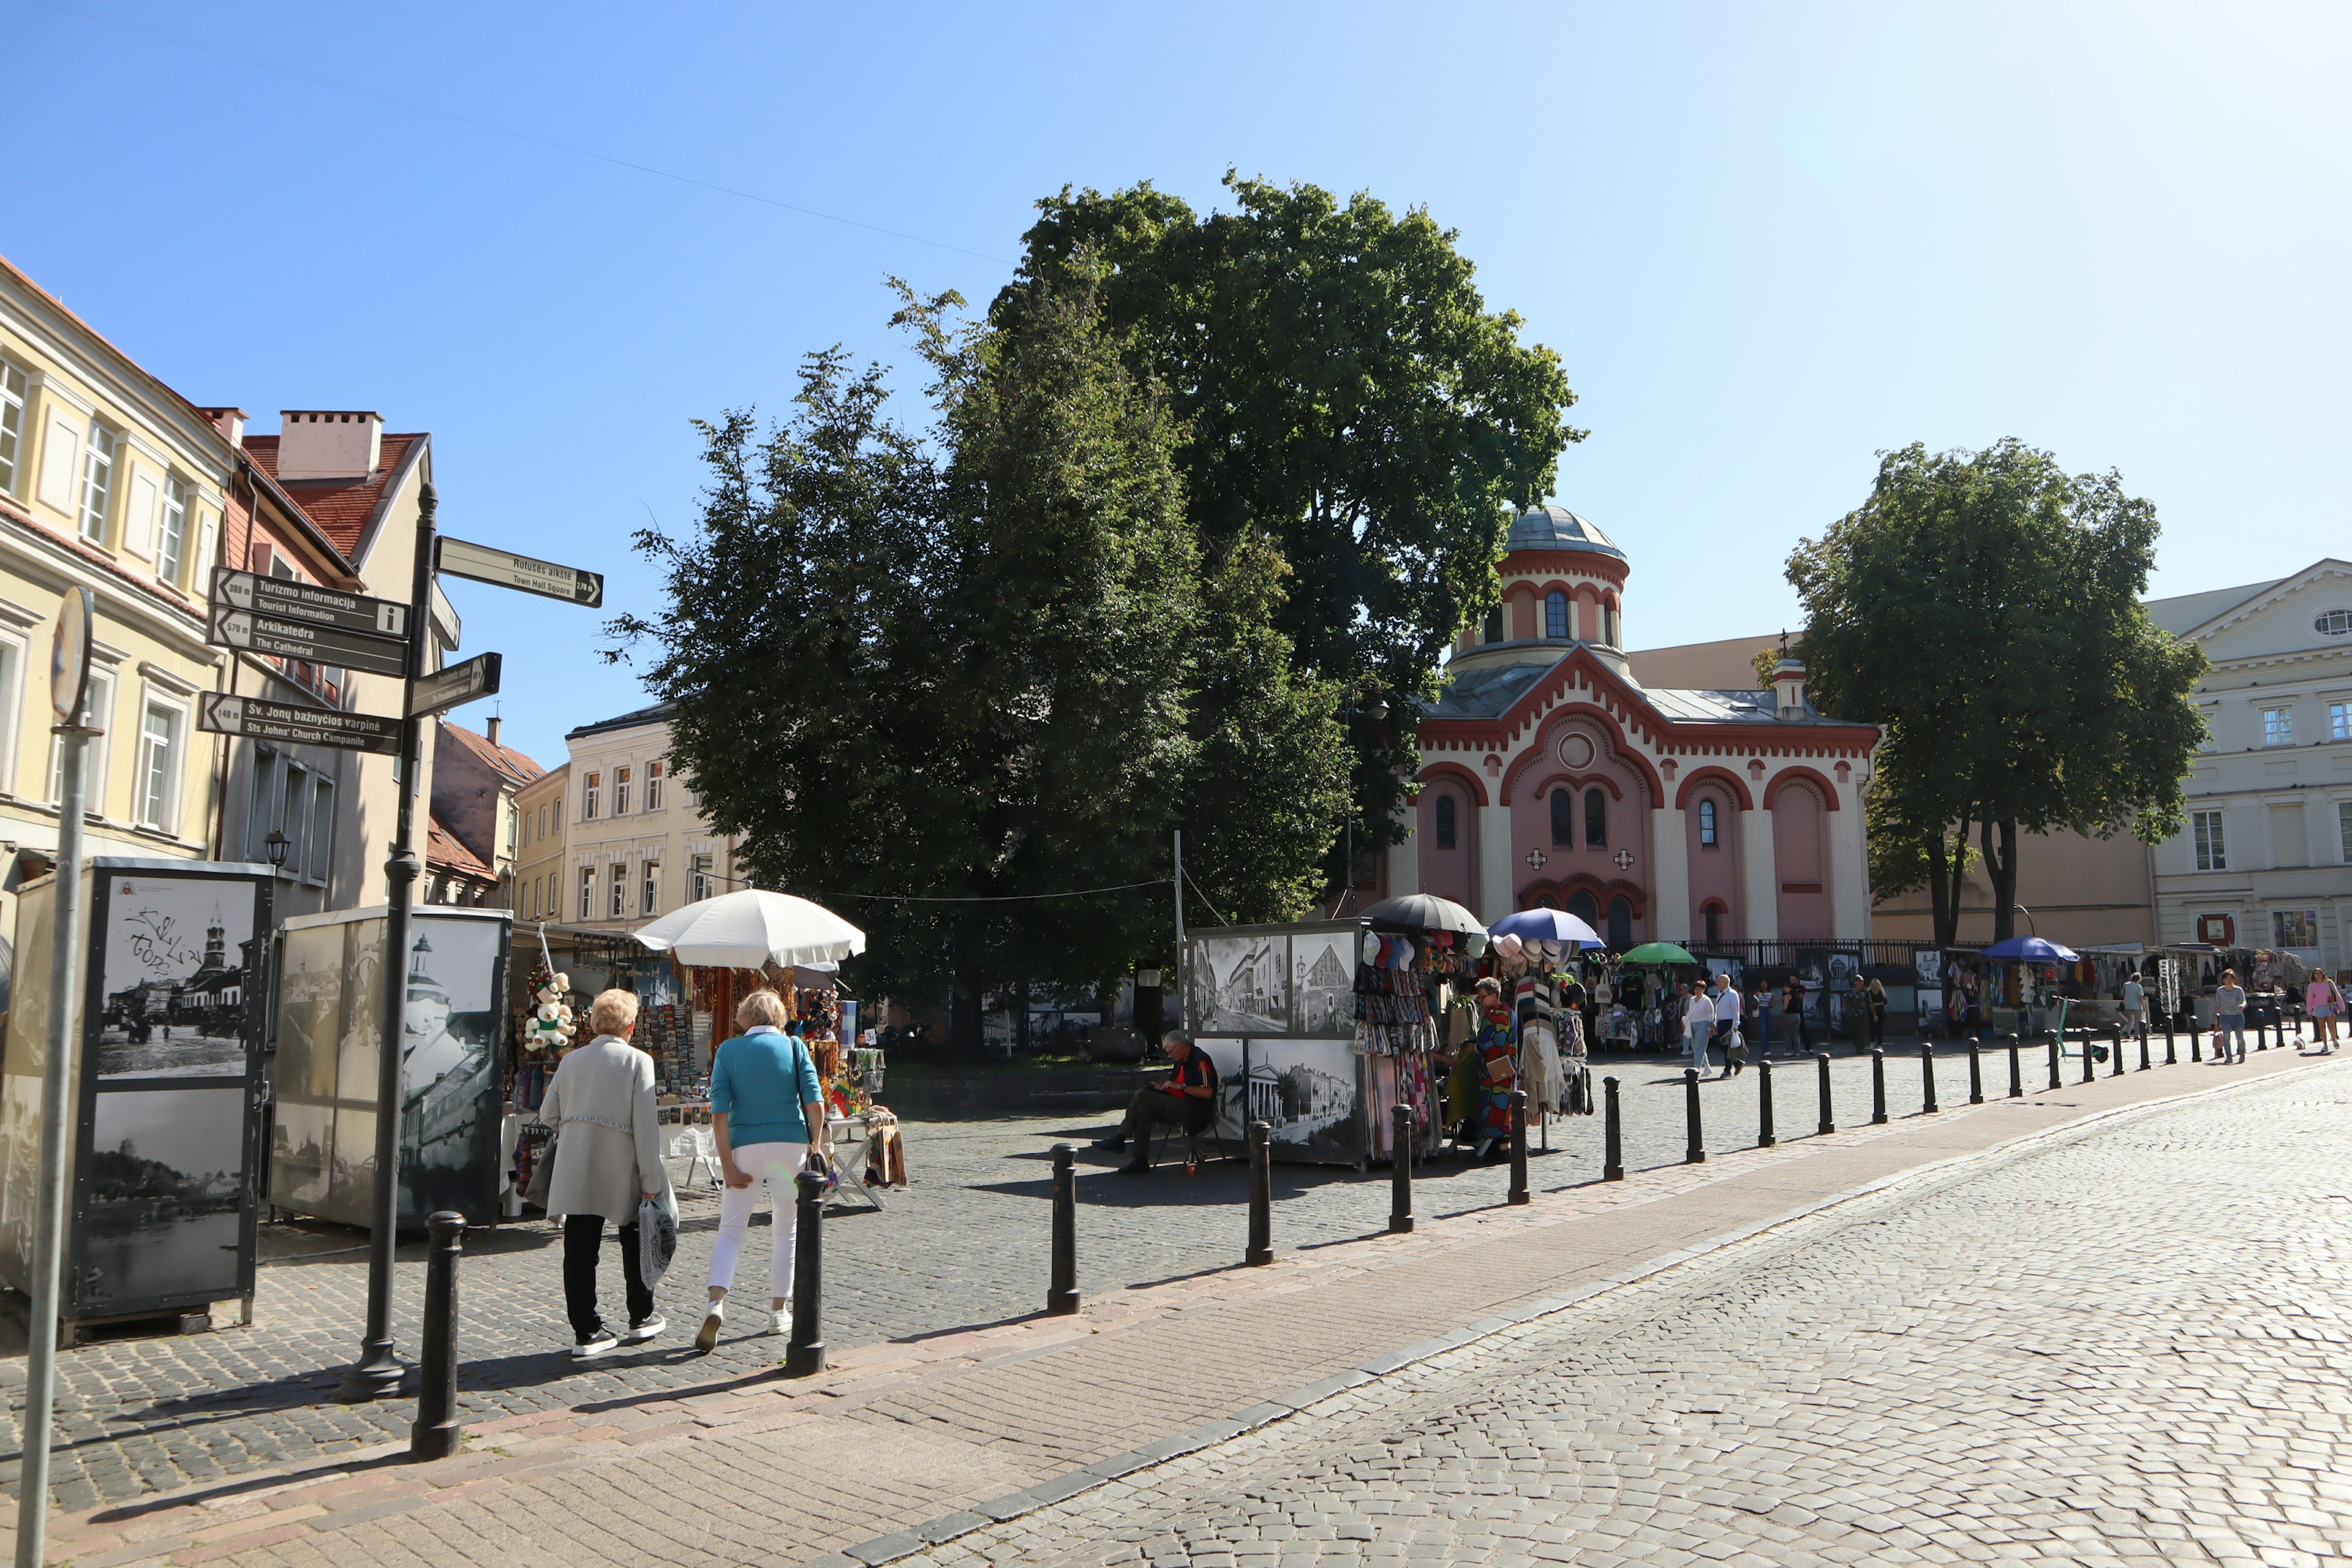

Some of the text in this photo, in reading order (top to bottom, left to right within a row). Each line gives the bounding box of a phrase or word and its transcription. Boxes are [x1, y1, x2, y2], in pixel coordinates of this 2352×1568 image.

[513, 558, 546, 575] Rotušės
[229, 584, 243, 594] 380
[259, 580, 356, 609] Turizmo informacija
[513, 575, 571, 595] Town Hall Square
[576, 582, 587, 591] 270
[258, 598, 335, 622] Tourist Information
[227, 622, 241, 633] 570
[257, 619, 314, 639] Arkikatedra
[255, 638, 313, 656] The Cathedral
[218, 709, 232, 719] 140
[248, 701, 381, 732] Šv. Jonų bažnyčios varpinė
[247, 722, 366, 746] Sts Johns' Church Campanile
